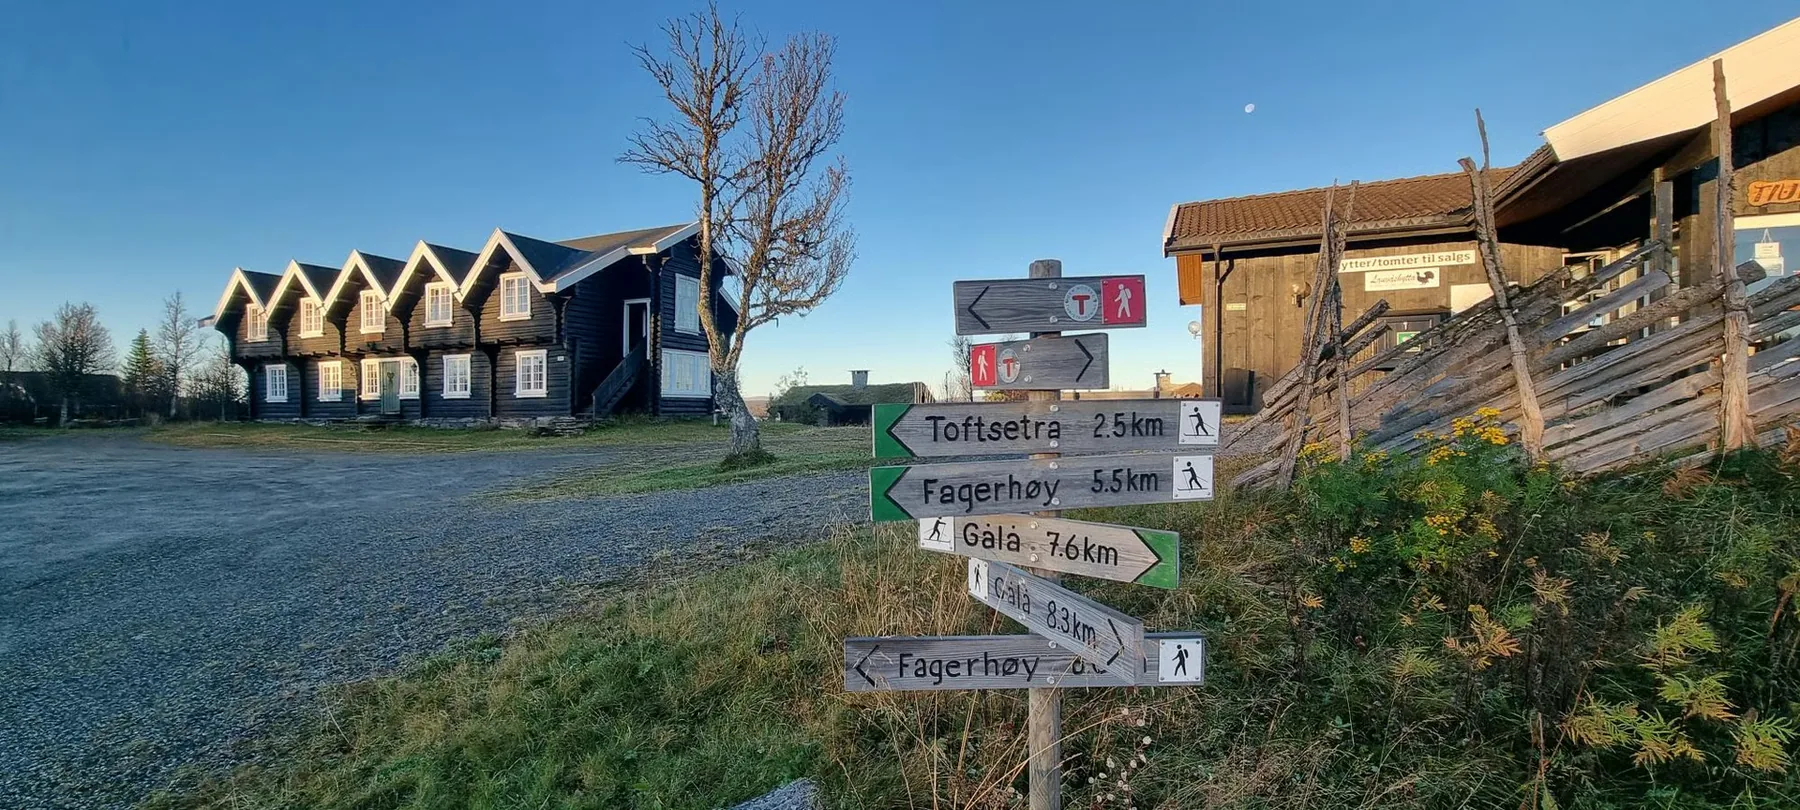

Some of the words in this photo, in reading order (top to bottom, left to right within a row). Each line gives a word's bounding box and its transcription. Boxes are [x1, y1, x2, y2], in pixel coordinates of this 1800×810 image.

[1754, 183, 1800, 202] TIU
[1341, 256, 1419, 270] ytter/tomter
[1422, 254, 1435, 264] til
[1438, 252, 1471, 263] salgs
[1072, 294, 1091, 316] T
[1003, 358, 1015, 378] T
[925, 415, 1061, 442] Toftsetra
[923, 474, 1060, 513] Fagerhøy
[963, 522, 1021, 552] Gålå
[899, 651, 1040, 686] Fagerhøy
